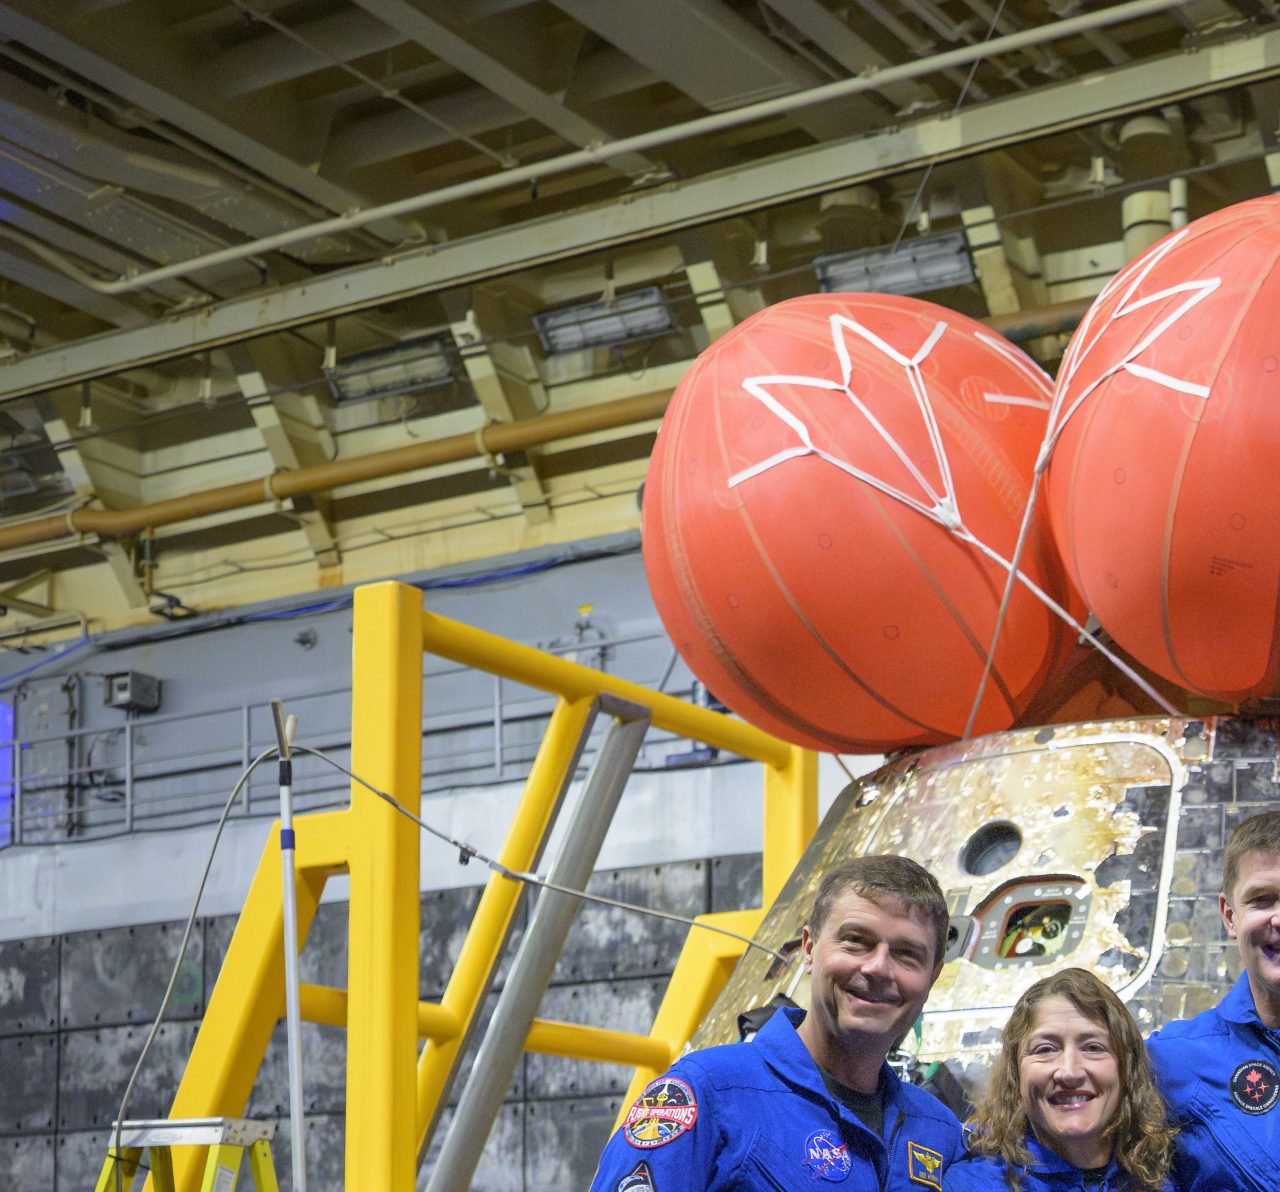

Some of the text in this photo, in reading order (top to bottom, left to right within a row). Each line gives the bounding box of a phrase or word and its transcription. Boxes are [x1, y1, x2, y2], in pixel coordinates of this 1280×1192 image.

[1232, 1064, 1249, 1083] CANADIAN
[1262, 1064, 1276, 1077] AGENCY
[625, 1105, 696, 1125] FLIGHT OPERATIONS
[808, 1147, 850, 1161] NASA
